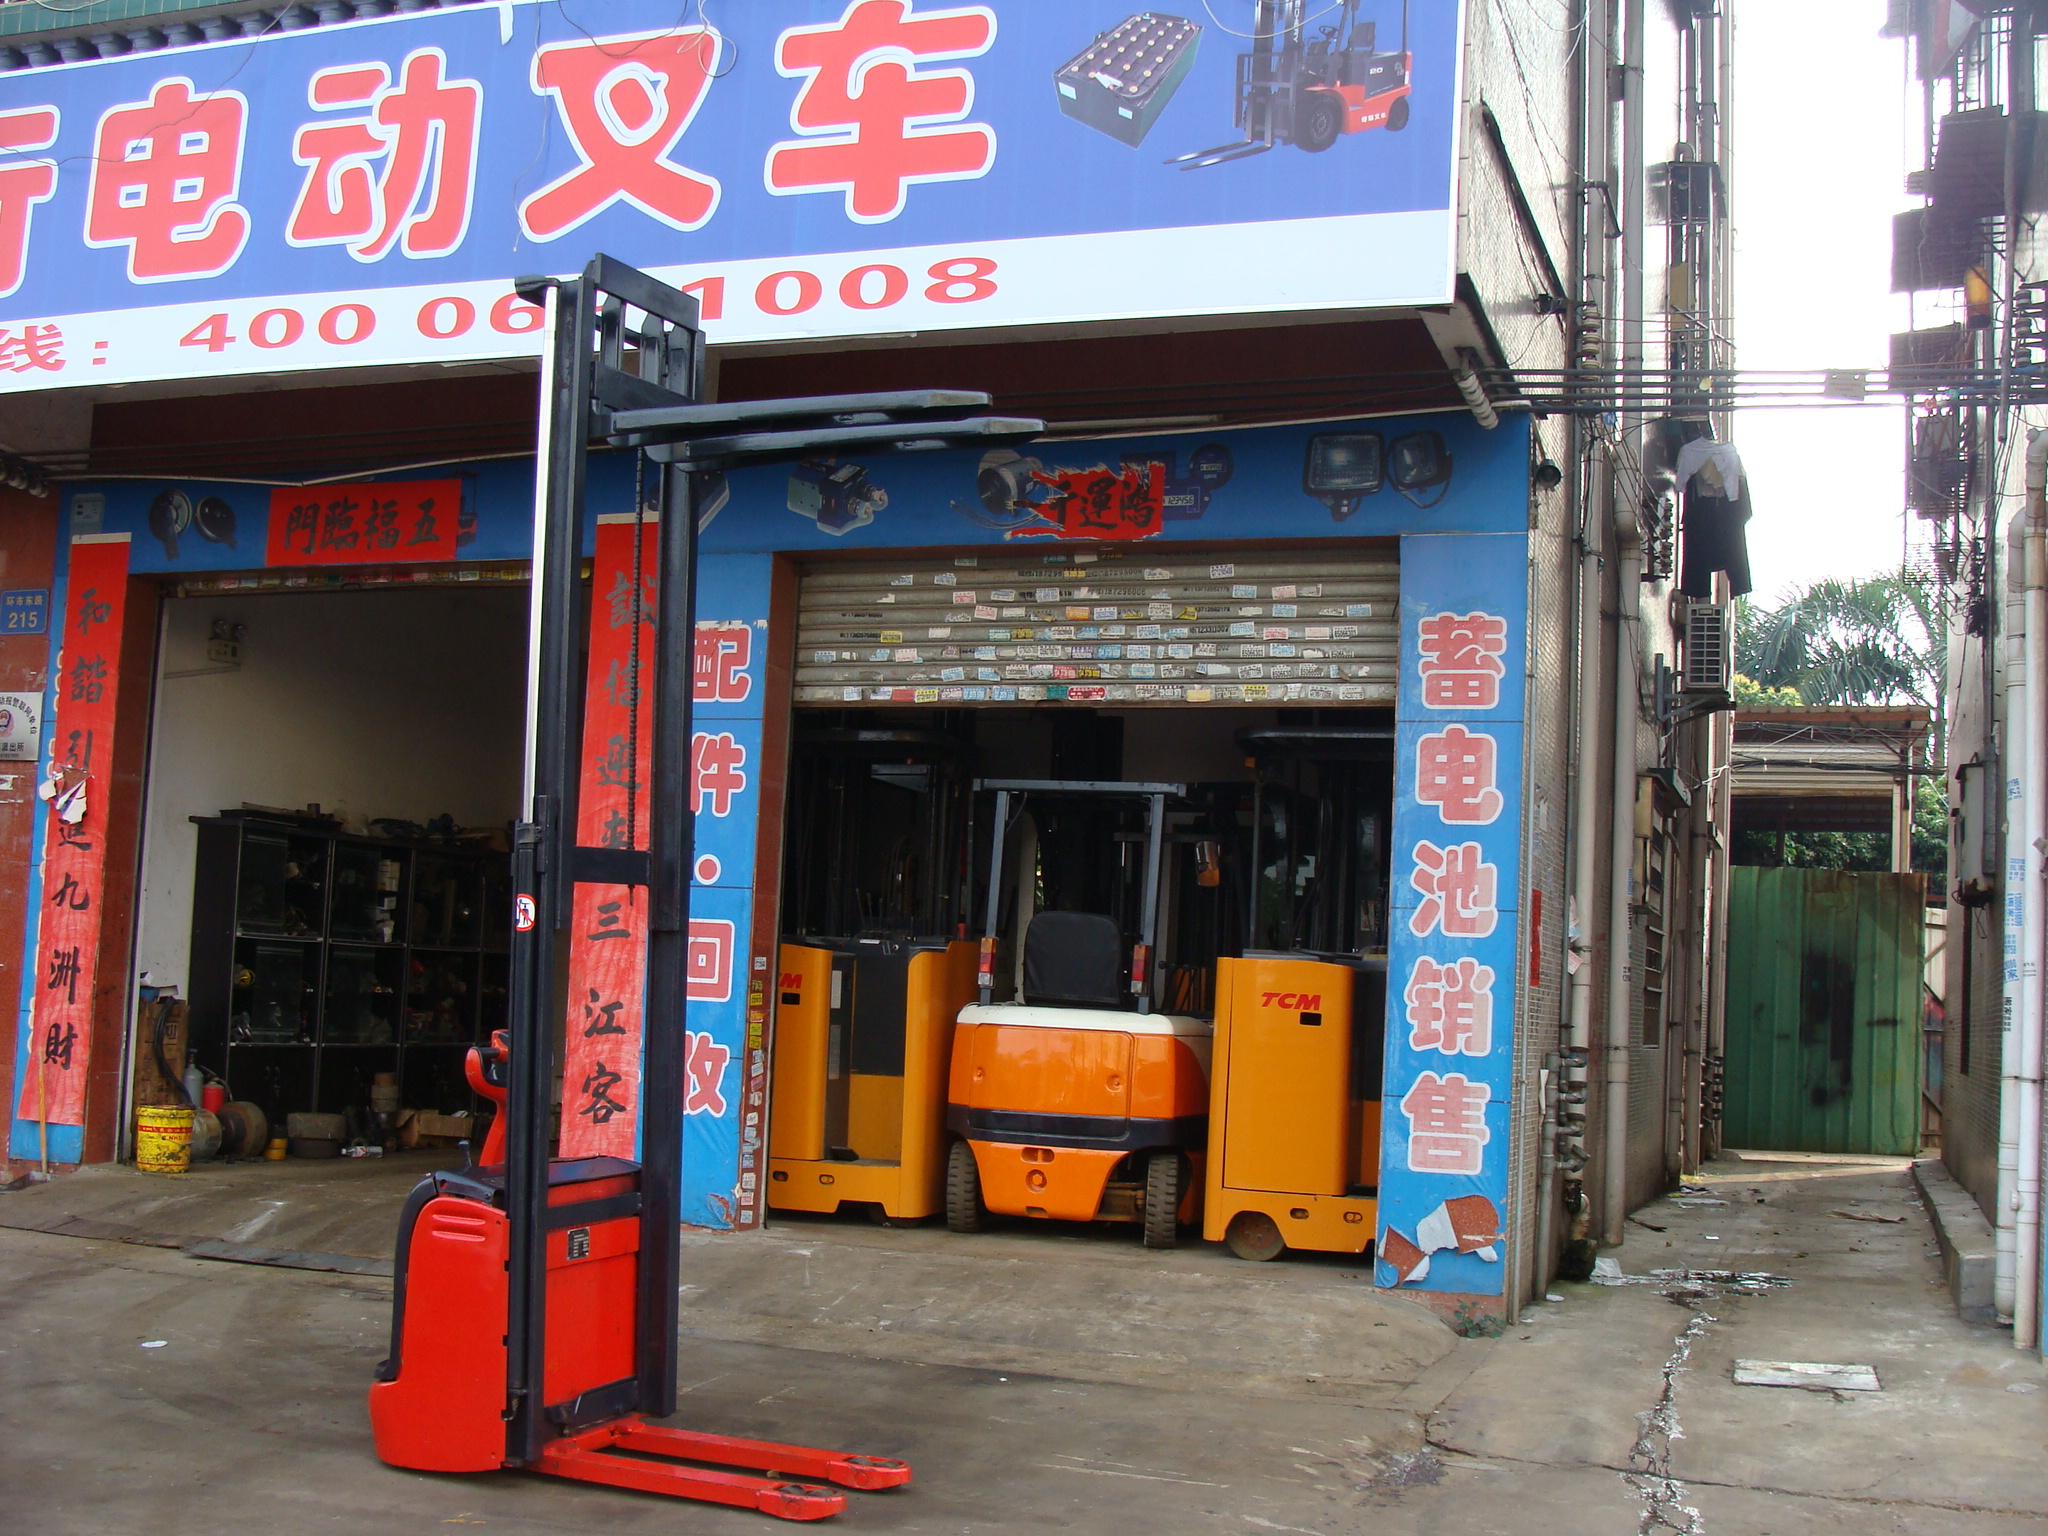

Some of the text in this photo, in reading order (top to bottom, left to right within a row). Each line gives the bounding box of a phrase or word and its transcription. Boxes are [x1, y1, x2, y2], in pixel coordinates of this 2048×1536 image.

[179, 302, 377, 353] 400
[681, 257, 998, 320] 1008
[8, 611, 39, 629] 215
[0, 742, 24, 752] 派出所
[1402, 610, 1508, 1176] 蓄电池销售
[1261, 992, 1322, 1011] TCM
